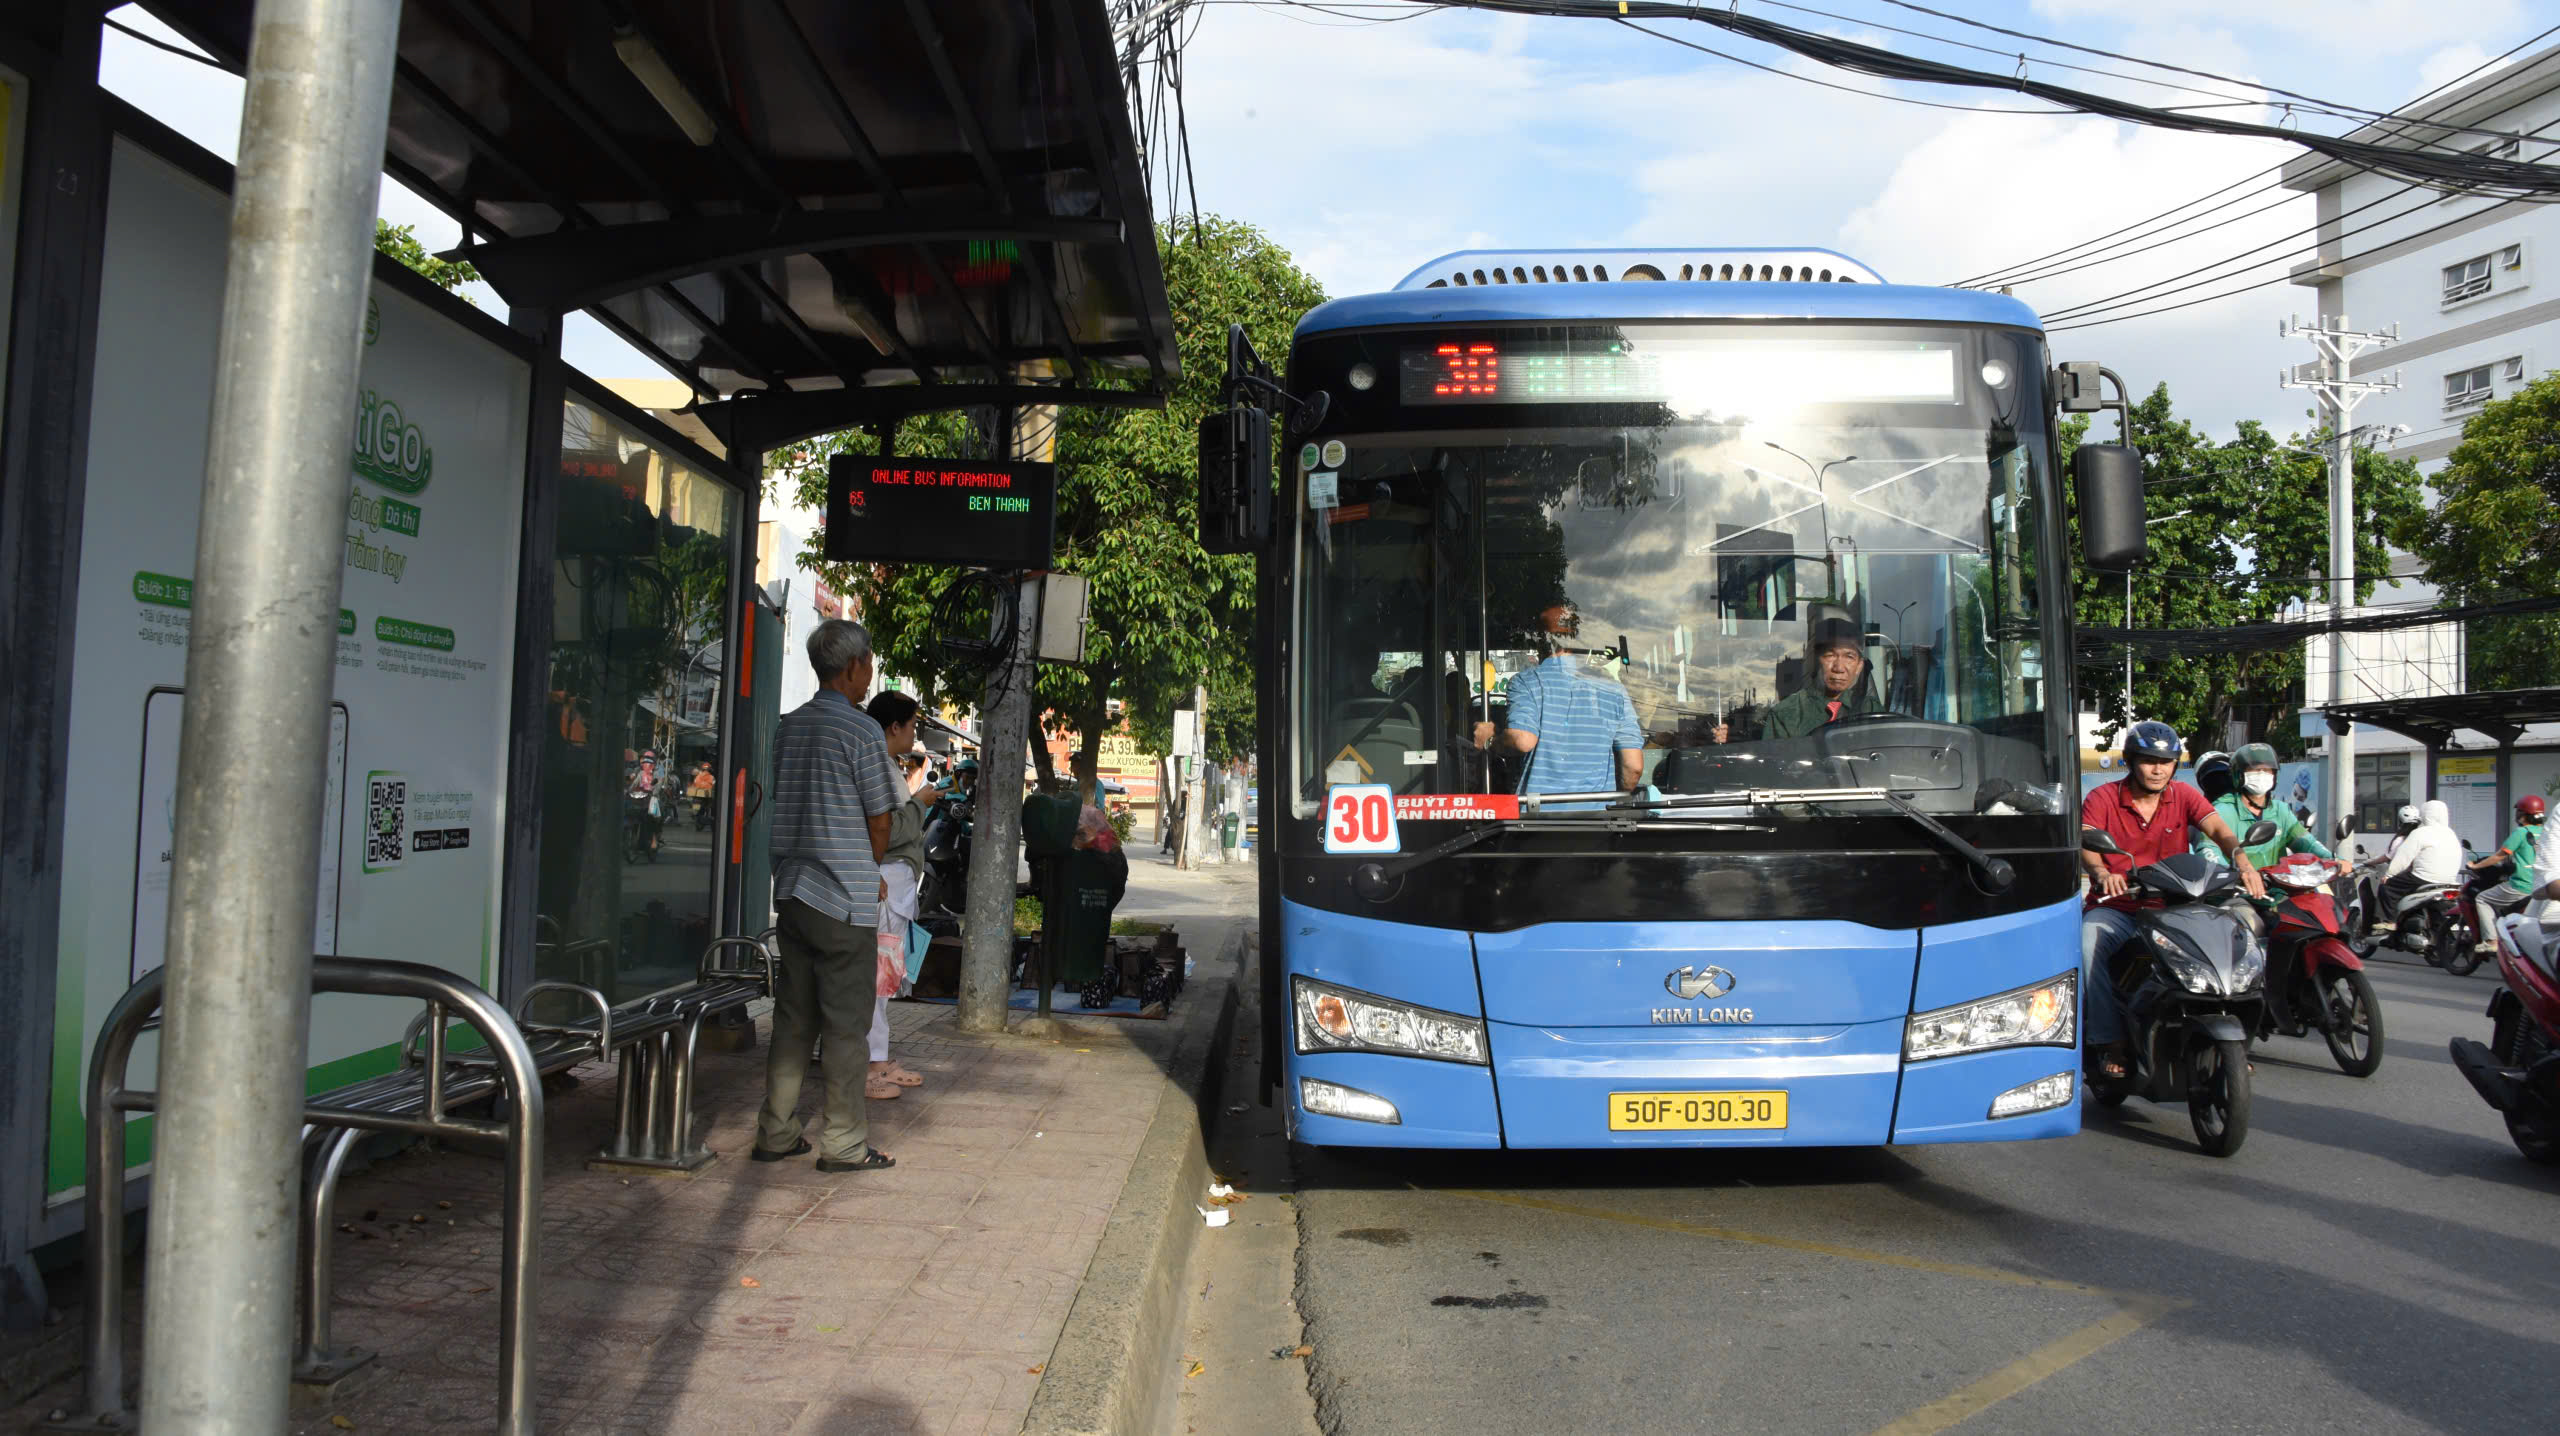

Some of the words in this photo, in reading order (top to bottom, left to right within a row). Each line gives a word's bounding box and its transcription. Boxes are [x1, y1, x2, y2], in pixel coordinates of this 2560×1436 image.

[1435, 347, 1497, 394] 30
[872, 469, 911, 485] ONLINE
[914, 471, 936, 485] BUS
[940, 472, 1011, 488] INFORMATION
[849, 490, 864, 506] 65
[969, 496, 991, 511] BEN
[995, 497, 1030, 512] THANH
[382, 545, 407, 584] tay
[1397, 796, 1448, 808] BUÝT
[1453, 797, 1473, 806] ĐI
[1333, 794, 1389, 843] 30
[1430, 809, 1496, 820] HƯƠNG
[1651, 1008, 1692, 1024] KIM
[1697, 1008, 1754, 1024] LONG
[1625, 1099, 1772, 1123] 50F-030.30
